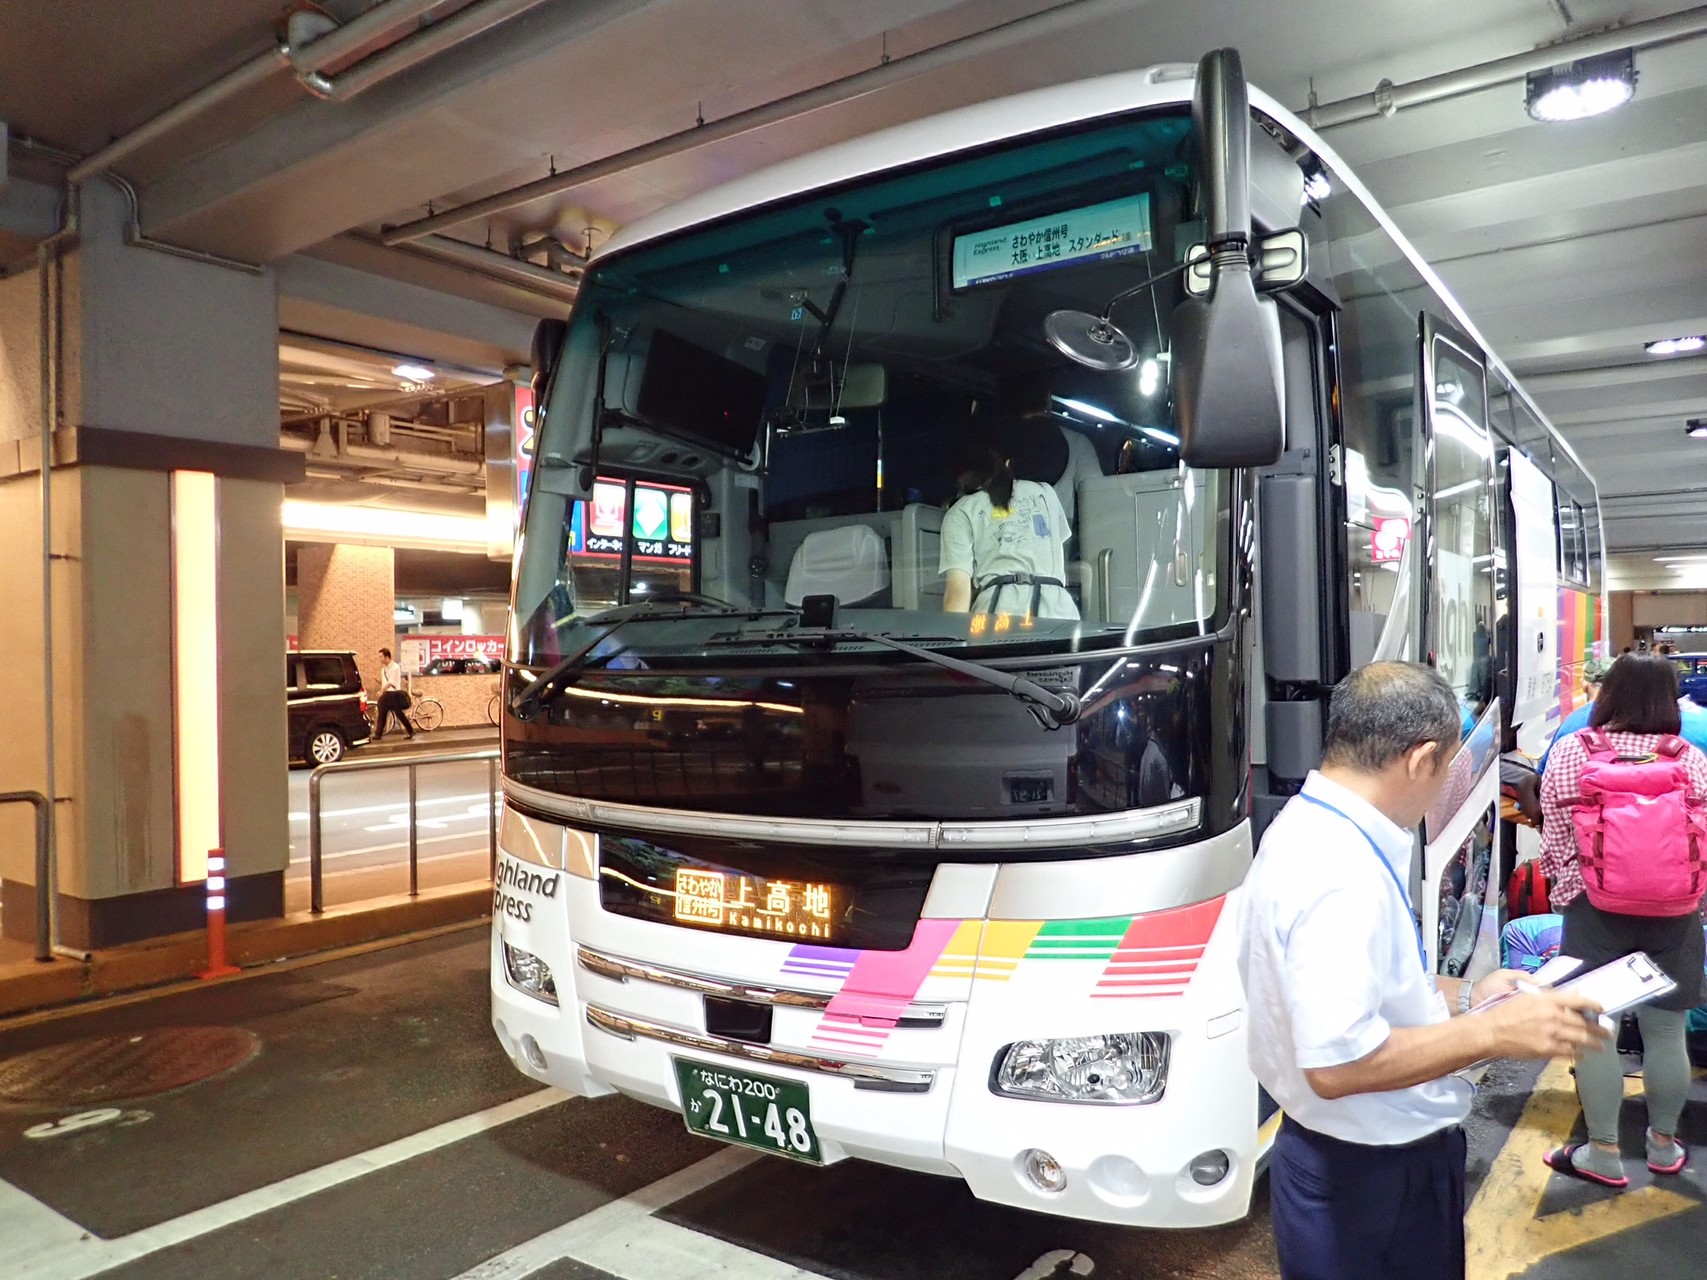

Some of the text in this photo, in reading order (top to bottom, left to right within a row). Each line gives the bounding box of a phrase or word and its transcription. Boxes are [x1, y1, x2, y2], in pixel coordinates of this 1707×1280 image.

[974, 237, 1007, 249] Highland
[1012, 224, 1069, 249] さわやか信州号
[973, 245, 1000, 256] Express
[638, 541, 663, 554] マンガ
[431, 639, 505, 653] コインロッカー
[497, 858, 560, 899] ghland
[678, 875, 722, 899] さわやか
[677, 897, 719, 918] 信州号
[729, 876, 830, 919] 上高地
[729, 911, 830, 938] Kamikochi
[690, 1088, 811, 1152] か 21-48
